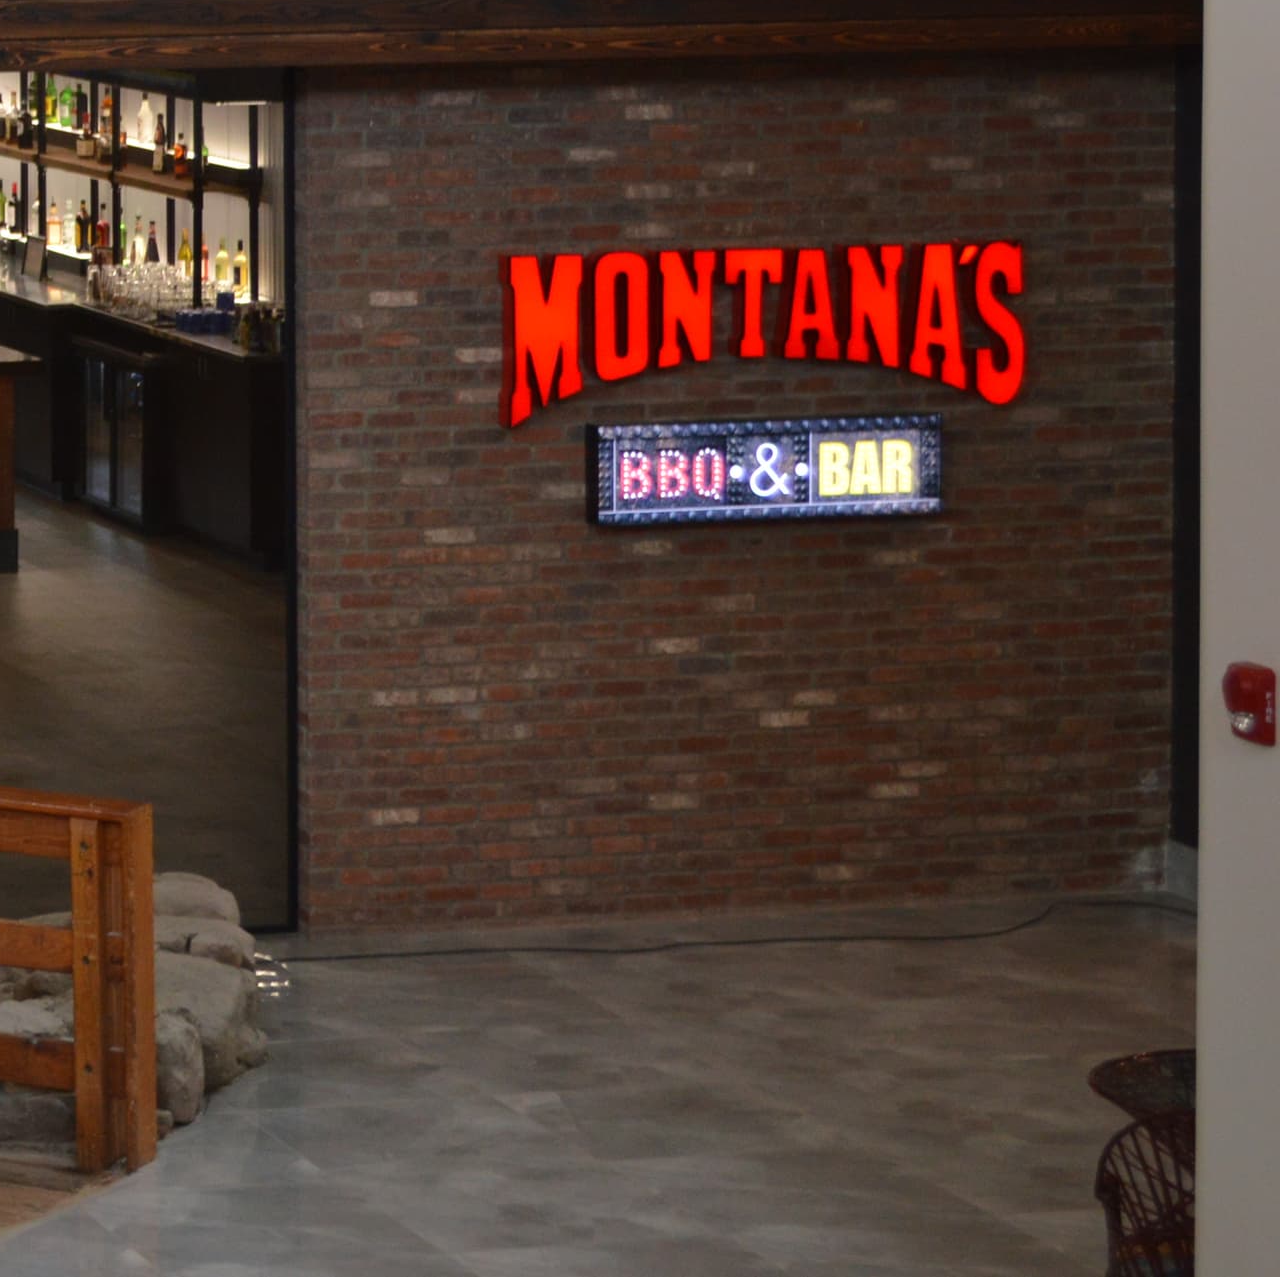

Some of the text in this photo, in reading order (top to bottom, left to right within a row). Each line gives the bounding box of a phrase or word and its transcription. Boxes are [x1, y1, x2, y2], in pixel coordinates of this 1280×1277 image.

[506, 240, 1026, 426] MONTANA'S
[620, 439, 914, 500] BBQ & BAR
